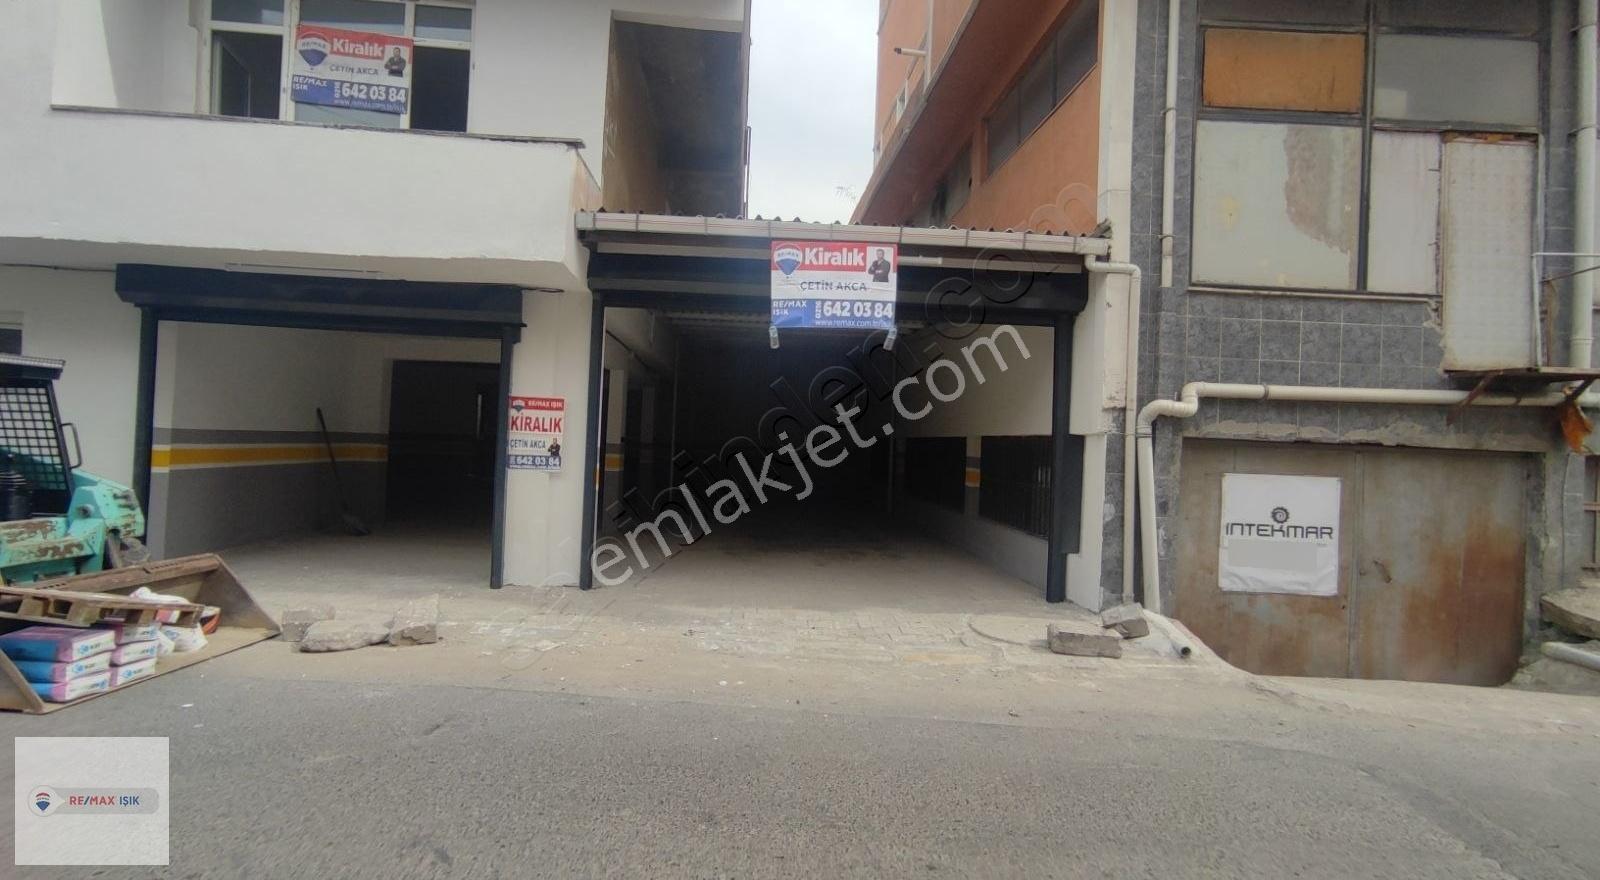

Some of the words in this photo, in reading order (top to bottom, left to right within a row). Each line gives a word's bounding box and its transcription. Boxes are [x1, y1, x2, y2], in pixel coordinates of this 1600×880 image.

[332, 38, 384, 57] Kiralık
[342, 82, 367, 99] 642
[369, 85, 386, 101] 03
[389, 88, 407, 102] 84
[804, 247, 865, 266] Kiralık
[773, 300, 807, 308] RE/MAX
[823, 301, 850, 317] 642
[853, 302, 872, 317] 03
[874, 303, 893, 318] 84
[511, 413, 562, 433] KİRALIK
[516, 456, 533, 465] 642
[534, 456, 546, 466] 03
[548, 457, 560, 467] 84
[1226, 522, 1334, 540] INTEKMAR
